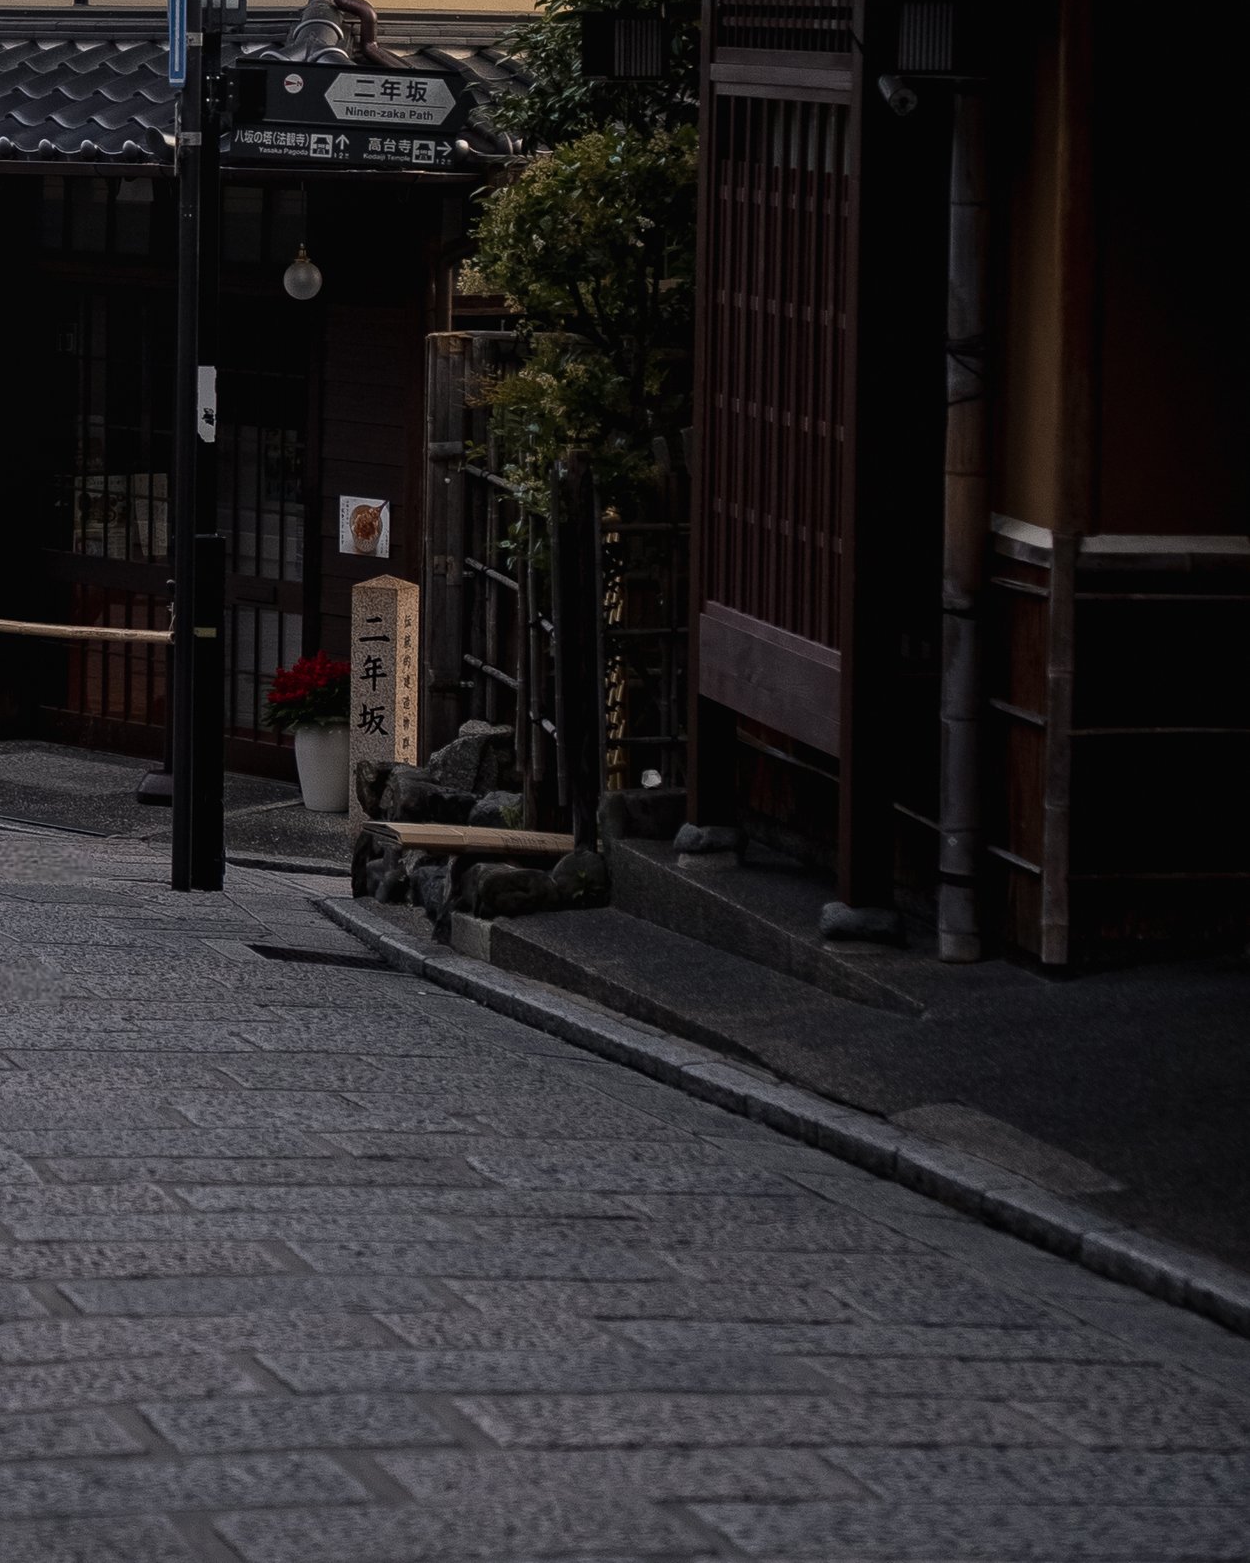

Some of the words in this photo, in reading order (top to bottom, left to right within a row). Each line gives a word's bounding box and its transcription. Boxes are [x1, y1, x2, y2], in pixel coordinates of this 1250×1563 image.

[354, 79, 428, 103] 二年坂
[345, 106, 406, 119] Ninen-zaka
[409, 110, 434, 121] Path
[258, 146, 283, 155] Yasaka
[283, 147, 309, 156] Pagoda
[368, 137, 412, 153] 高台寺
[387, 153, 411, 163] Temple
[357, 616, 390, 736] 二年坂
